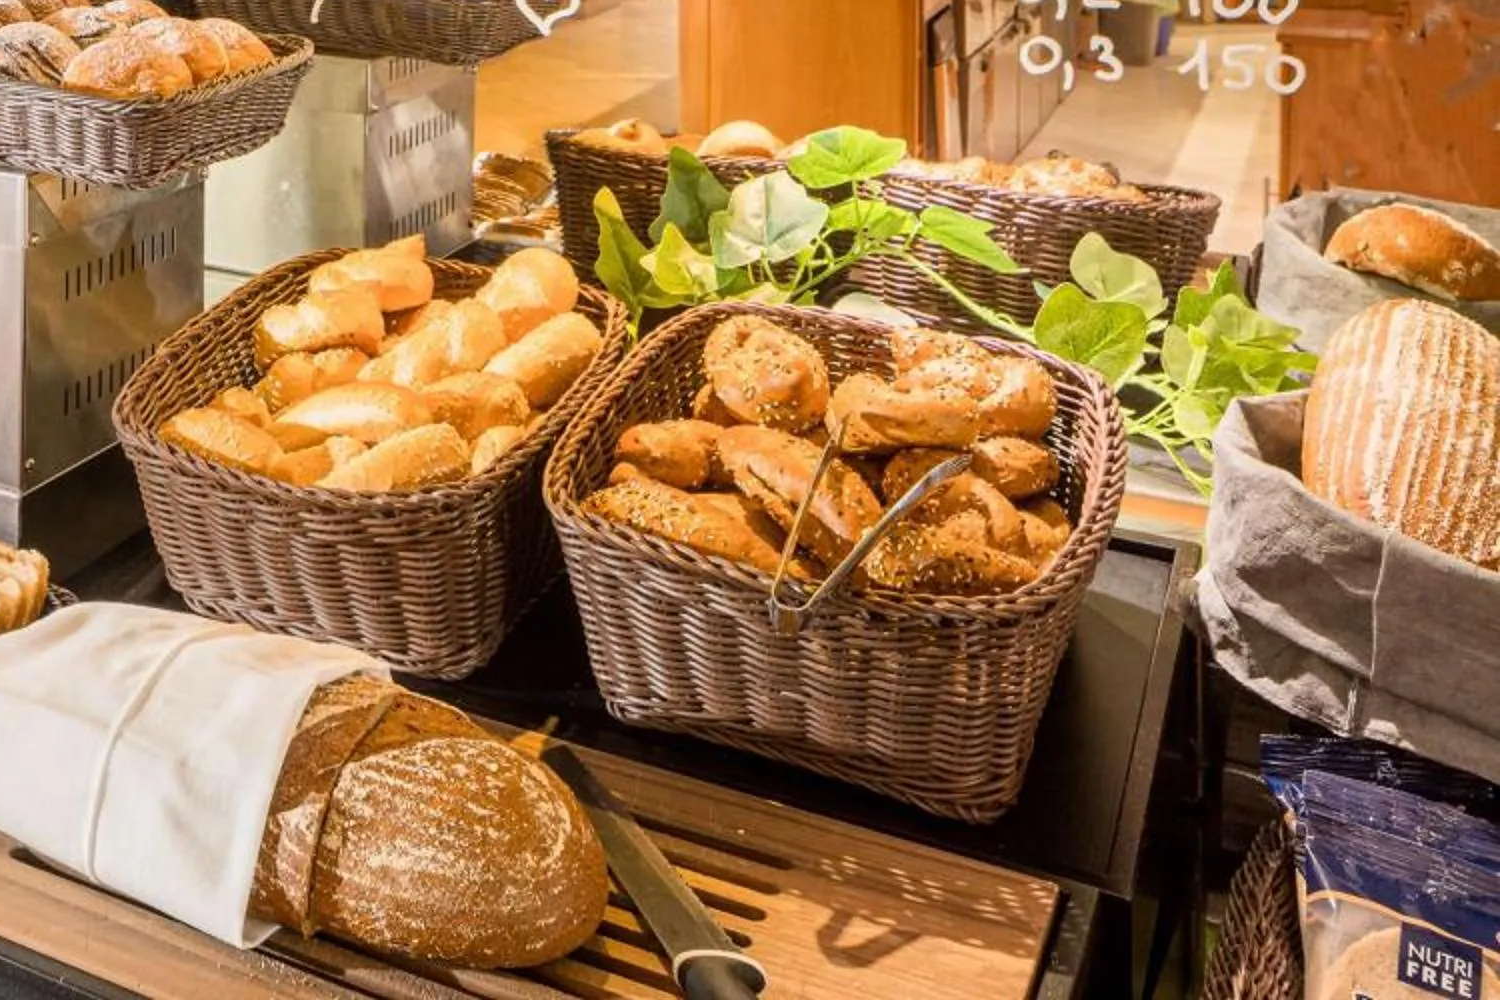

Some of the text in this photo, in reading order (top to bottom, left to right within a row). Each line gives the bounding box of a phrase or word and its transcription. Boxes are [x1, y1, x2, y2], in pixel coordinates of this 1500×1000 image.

[1019, 35, 1307, 95] 0,3 150
[1407, 940, 1474, 979] NUTRI
[1405, 960, 1474, 999] FREE
